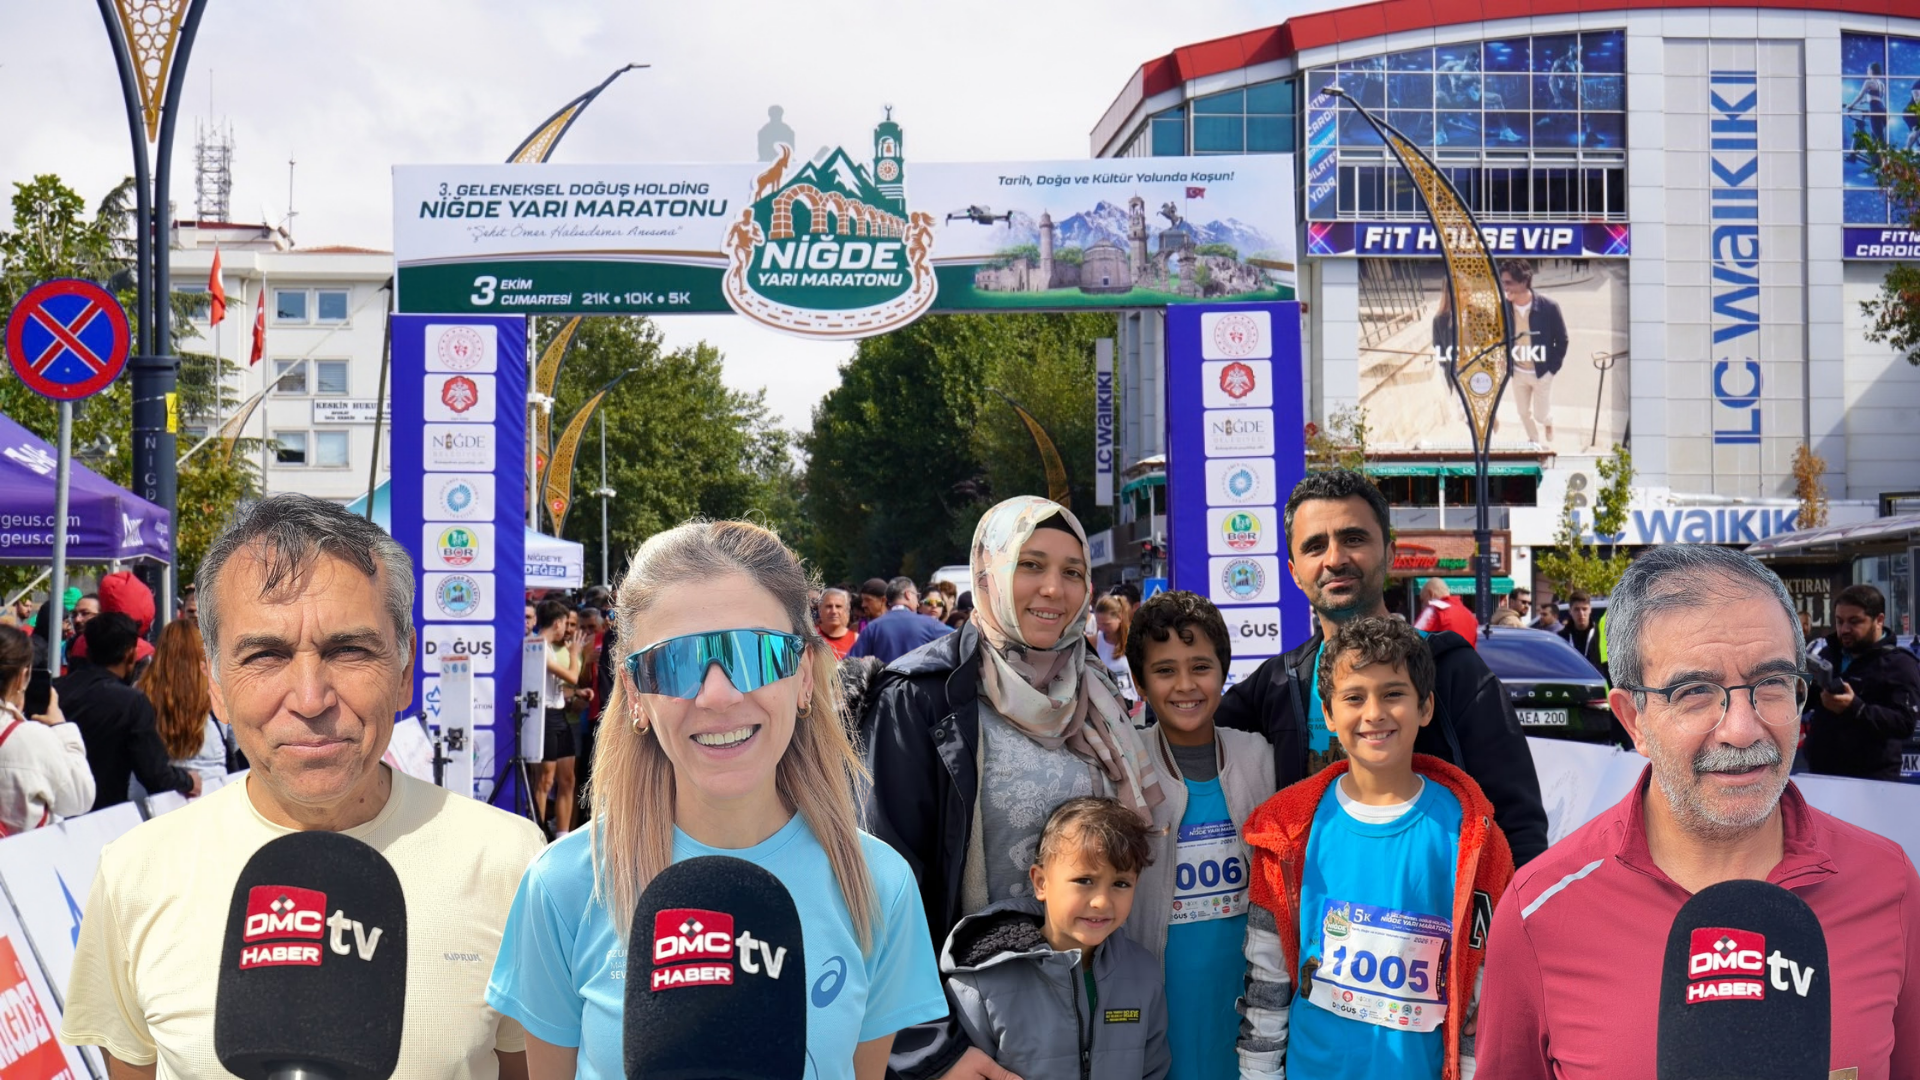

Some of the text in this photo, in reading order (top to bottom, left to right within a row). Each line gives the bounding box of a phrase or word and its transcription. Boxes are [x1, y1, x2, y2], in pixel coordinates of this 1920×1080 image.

[998, 171, 1235, 187] Tarih, Doğa ve Kültür Yolunda Koşun!
[438, 180, 710, 198] 3. GELENEKSEL DOĞUŞ HOLDİNG
[419, 195, 728, 219] NİĞDE YARI MARATONU
[760, 235, 902, 270] NİĞDE
[500, 277, 533, 290] EKİM
[757, 273, 903, 287] YARI MARATONU
[470, 275, 498, 306] 3
[500, 292, 573, 306] CUMARTESİ
[581, 291, 692, 305] 21K 10K 5K
[352, 401, 378, 410] HUKU
[1714, 357, 1762, 444] LC
[1097, 449, 1112, 474] LC
[0, 513, 81, 528] geus.cm
[0, 532, 80, 548] geus.cm
[1227, 532, 1256, 541] BOR
[444, 547, 474, 557] BOR
[1782, 578, 1831, 593] KTIRAN
[1543, 711, 1566, 724] 200
[246, 910, 323, 938] DMC
[1353, 908, 1372, 923] 5K
[326, 909, 384, 962] tv
[655, 931, 732, 960] DMC
[735, 929, 788, 980] tv
[241, 946, 320, 966] HABER
[1690, 949, 1763, 975] DMC
[653, 966, 732, 988] HABER
[1332, 945, 1430, 993] 1005
[1766, 949, 1816, 998] tv
[1688, 982, 1763, 1001] HABER
